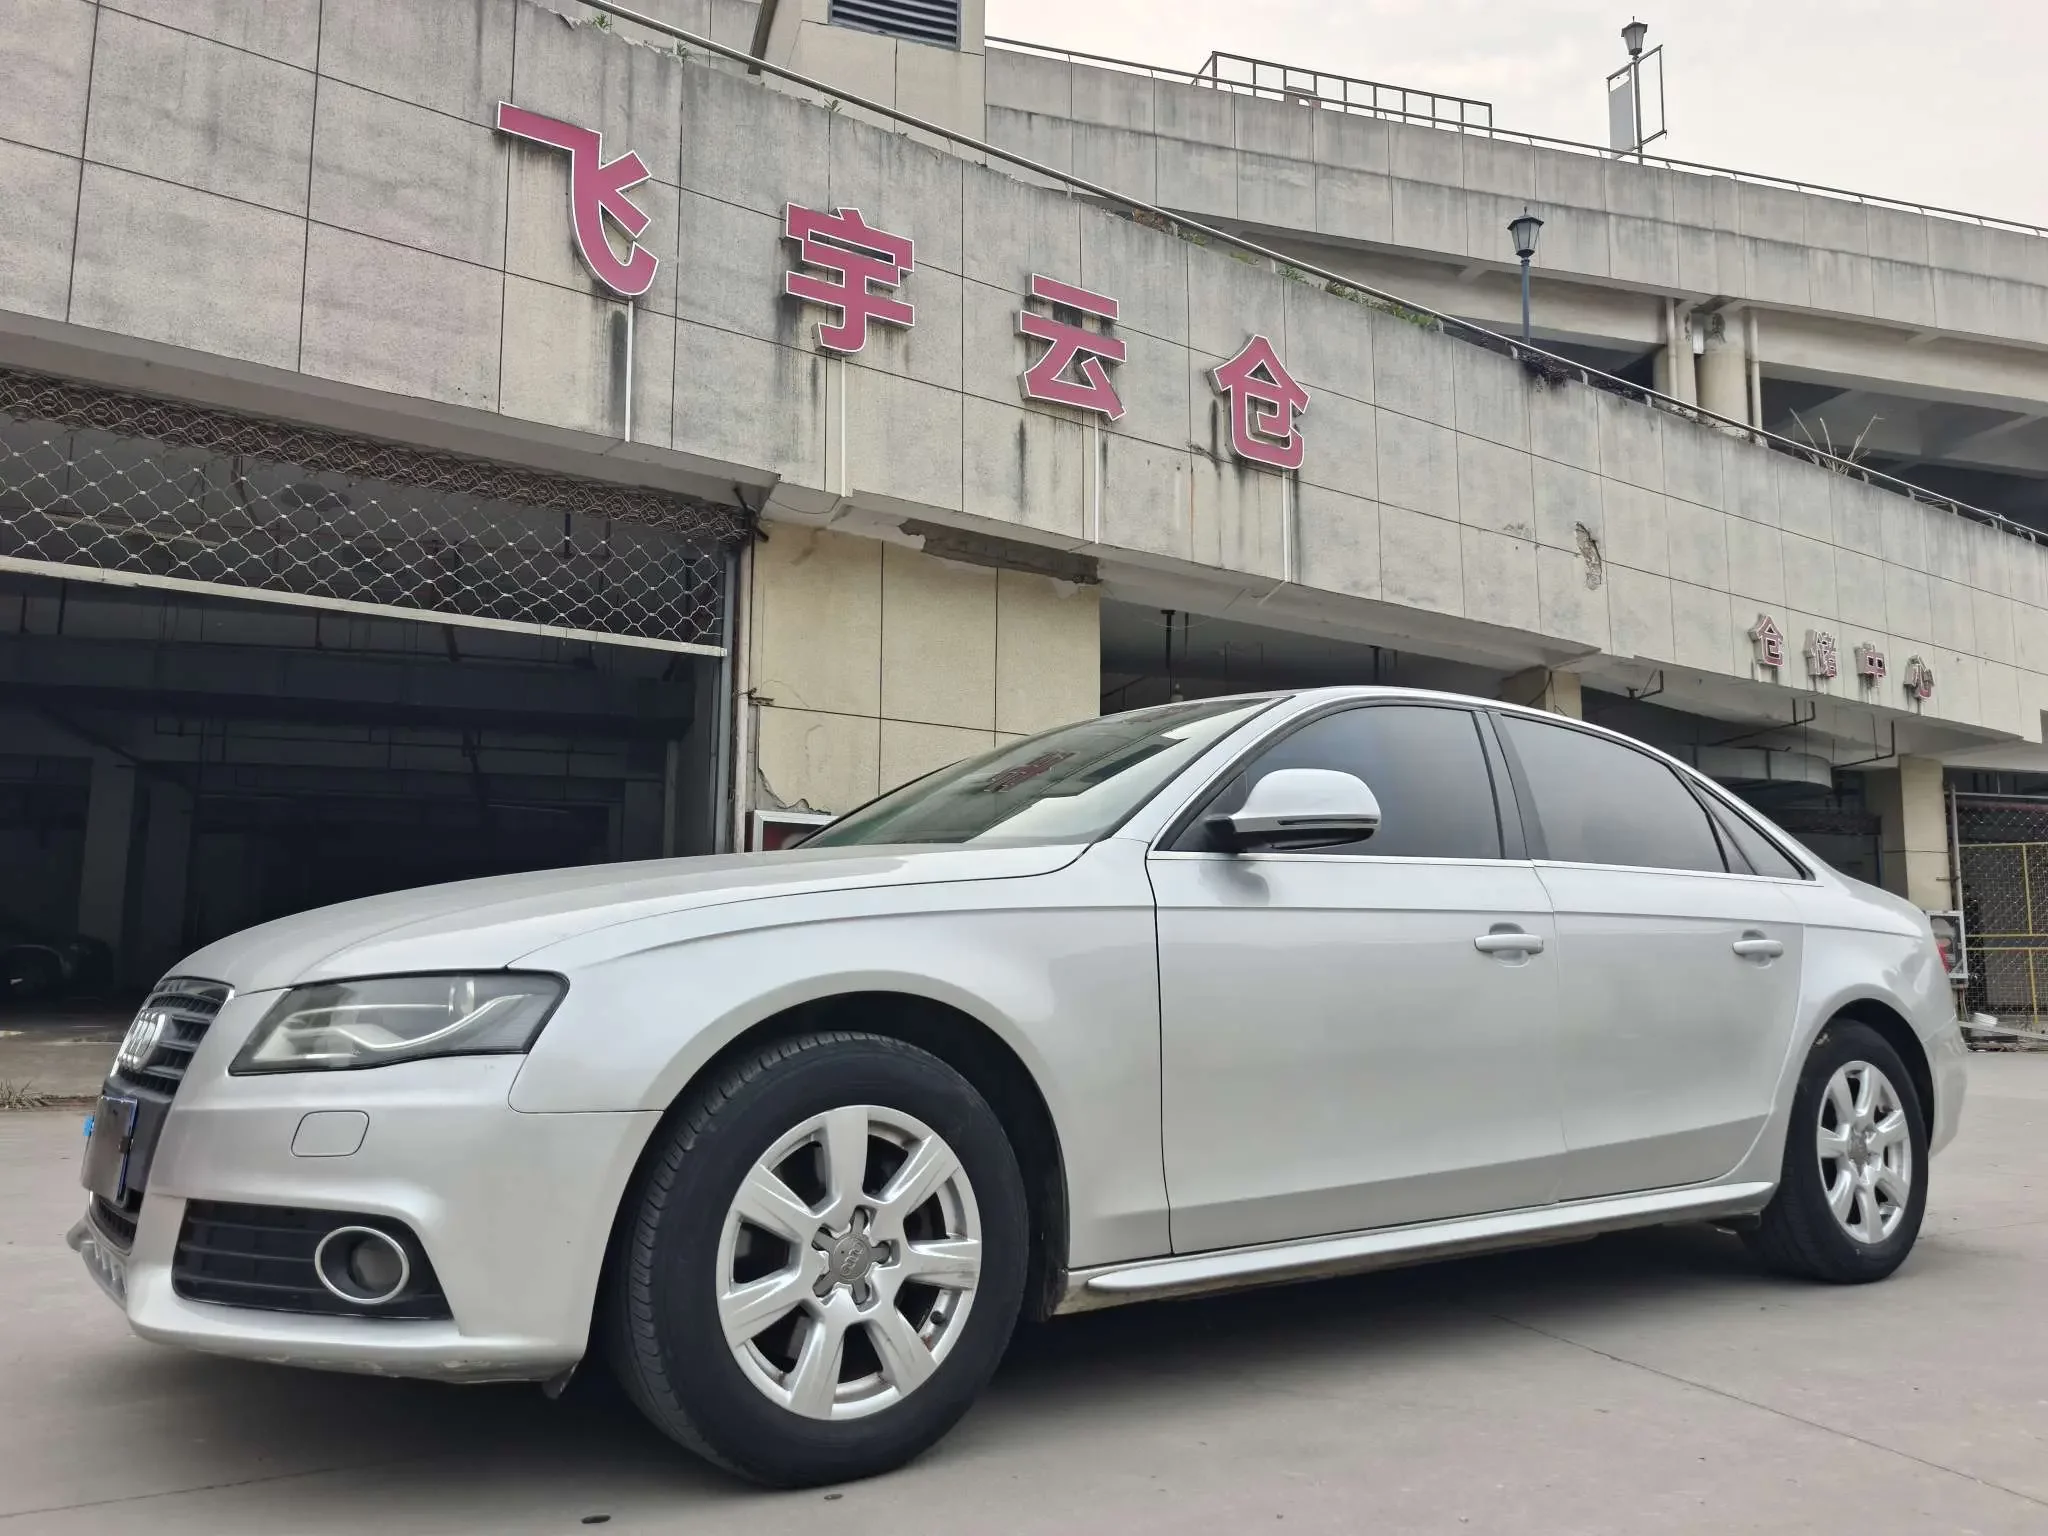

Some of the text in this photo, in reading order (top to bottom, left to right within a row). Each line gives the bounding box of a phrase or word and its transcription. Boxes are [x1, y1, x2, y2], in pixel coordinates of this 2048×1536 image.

[497, 101, 1309, 469] 飞宇云仓
[1749, 613, 1934, 699] 仓储中心
